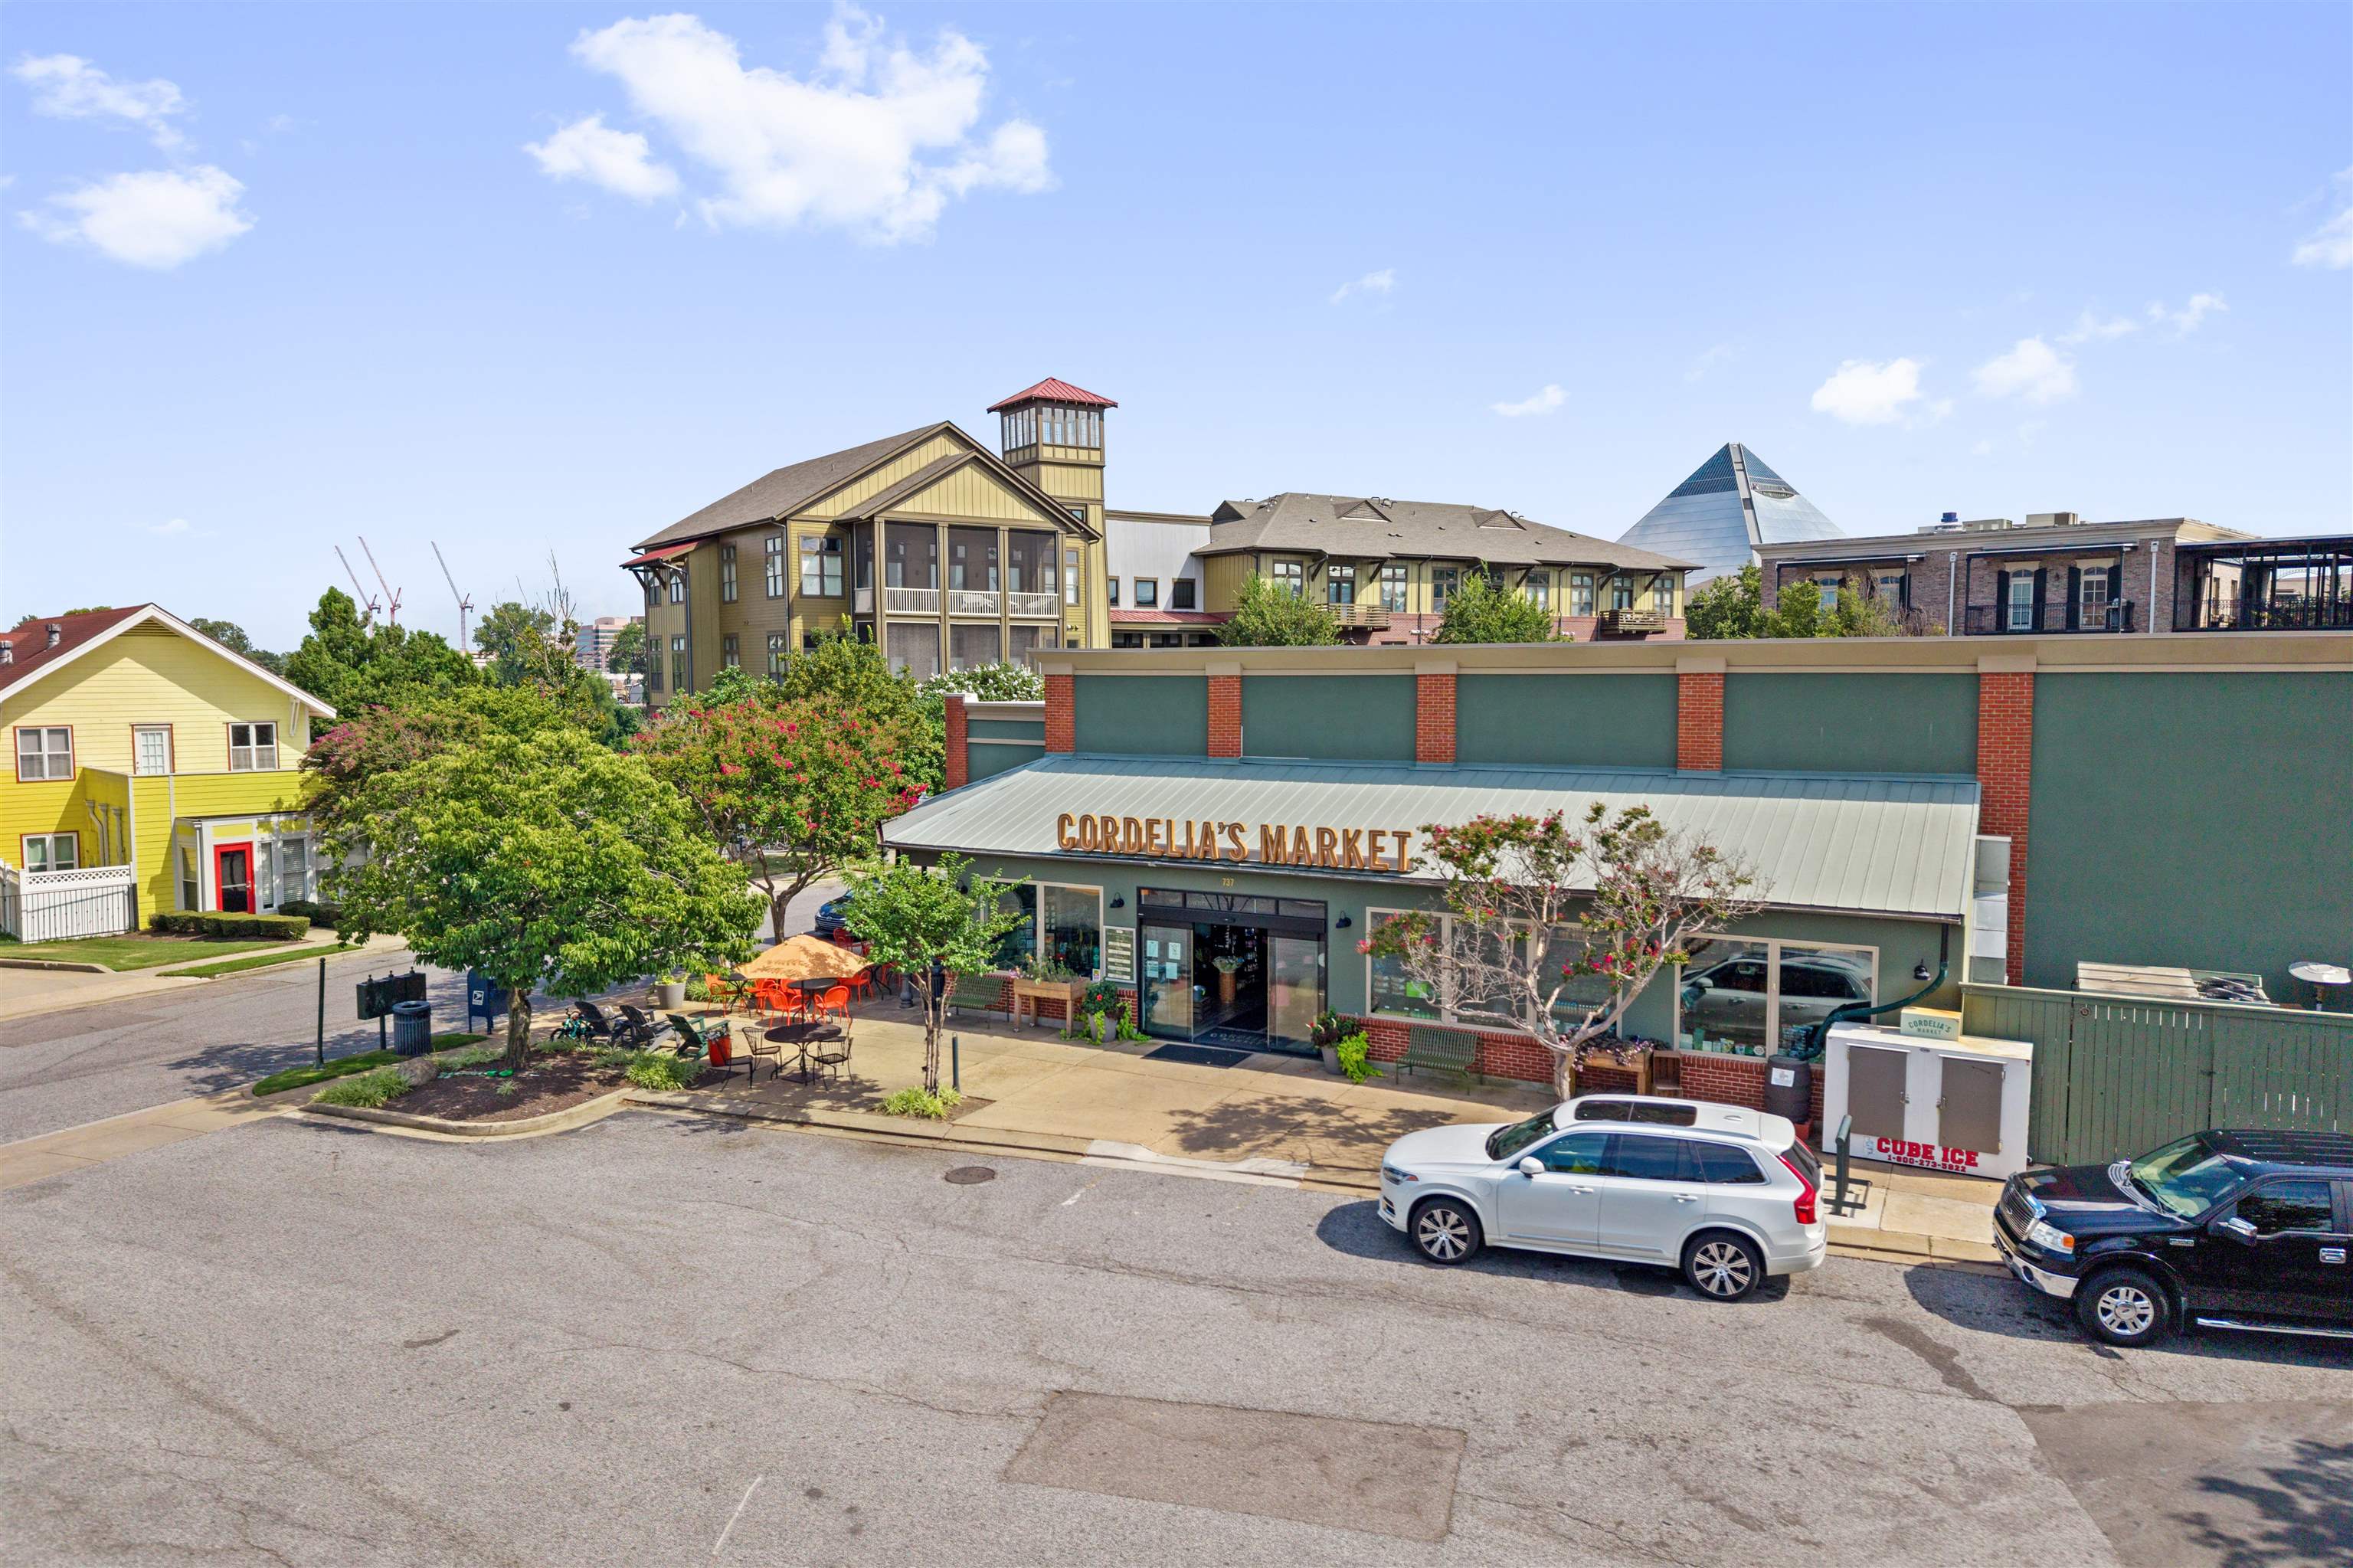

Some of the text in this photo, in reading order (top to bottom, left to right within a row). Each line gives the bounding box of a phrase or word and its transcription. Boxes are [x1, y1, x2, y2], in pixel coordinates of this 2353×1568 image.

[1058, 813, 1413, 872] CORDELIA'S MARKET
[1222, 877, 1234, 886] 737
[1908, 1020, 1952, 1033] CORDELIA'S
[1877, 1137, 1978, 1167] CUBE ICE
